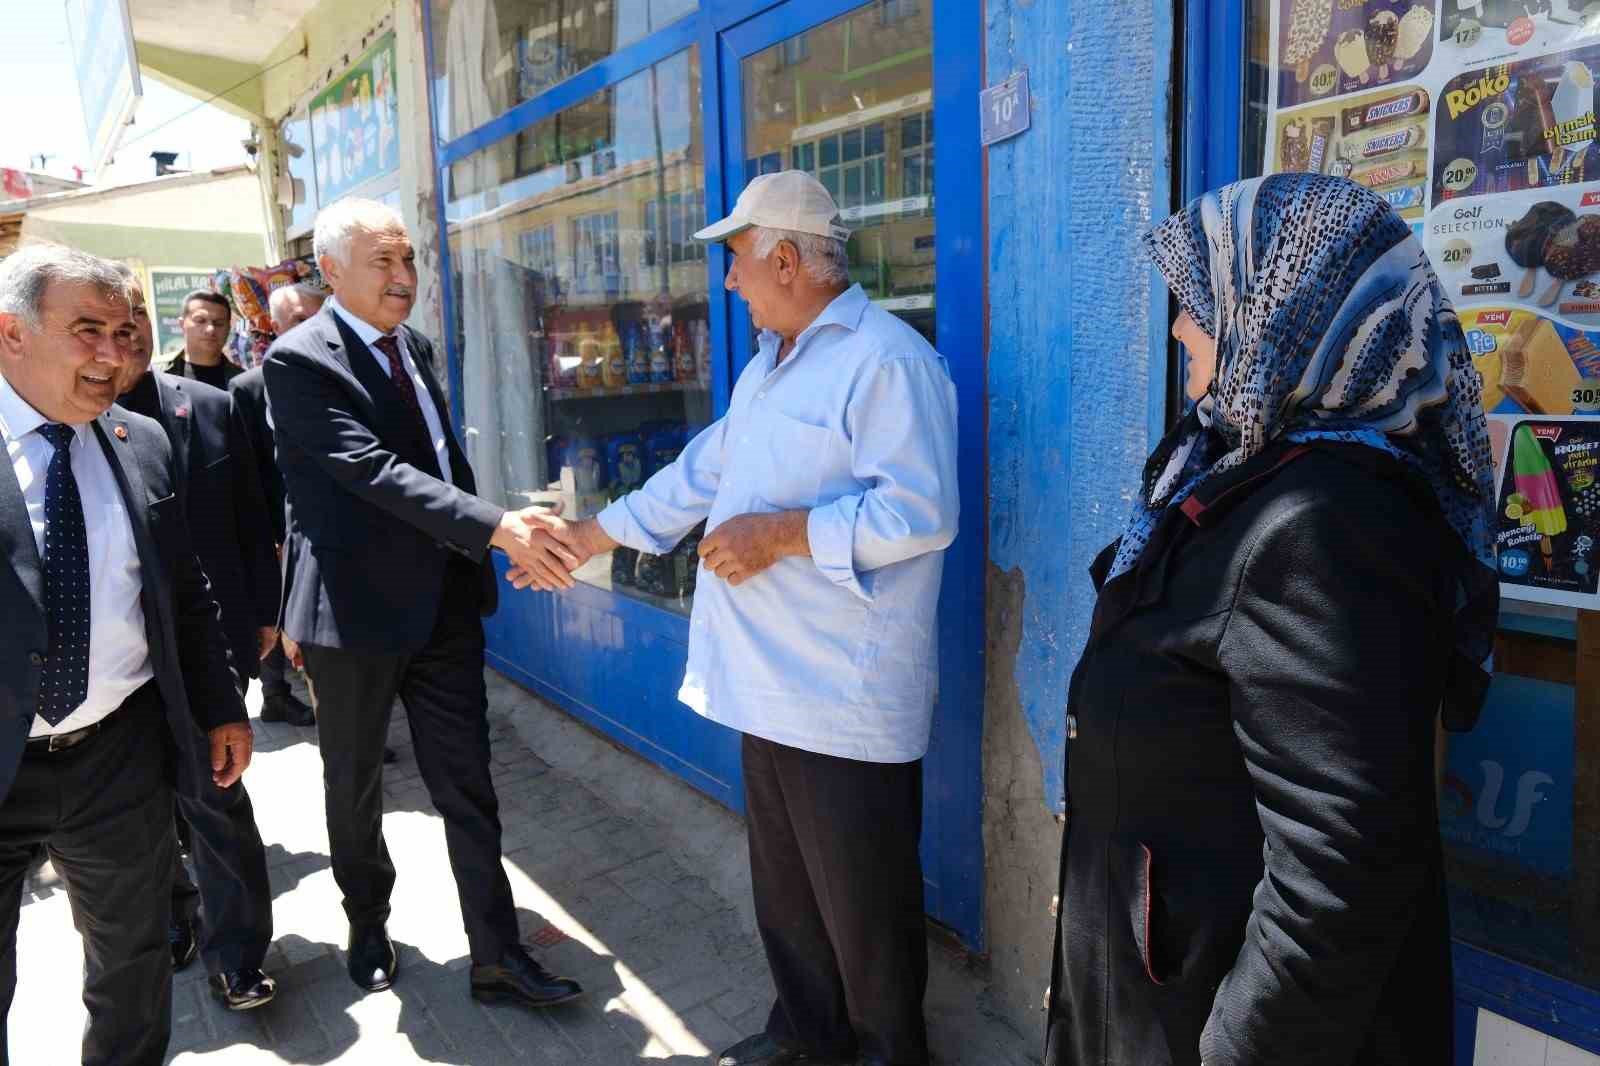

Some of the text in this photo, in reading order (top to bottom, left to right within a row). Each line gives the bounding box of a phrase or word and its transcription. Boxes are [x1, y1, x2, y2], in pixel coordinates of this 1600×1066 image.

[1446, 74, 1510, 120] Roko
[1366, 98, 1411, 121] SNICKERS
[1364, 131, 1407, 153] SNICKERS
[1454, 206, 1483, 220] Golf
[1433, 217, 1504, 235] SELECTION
